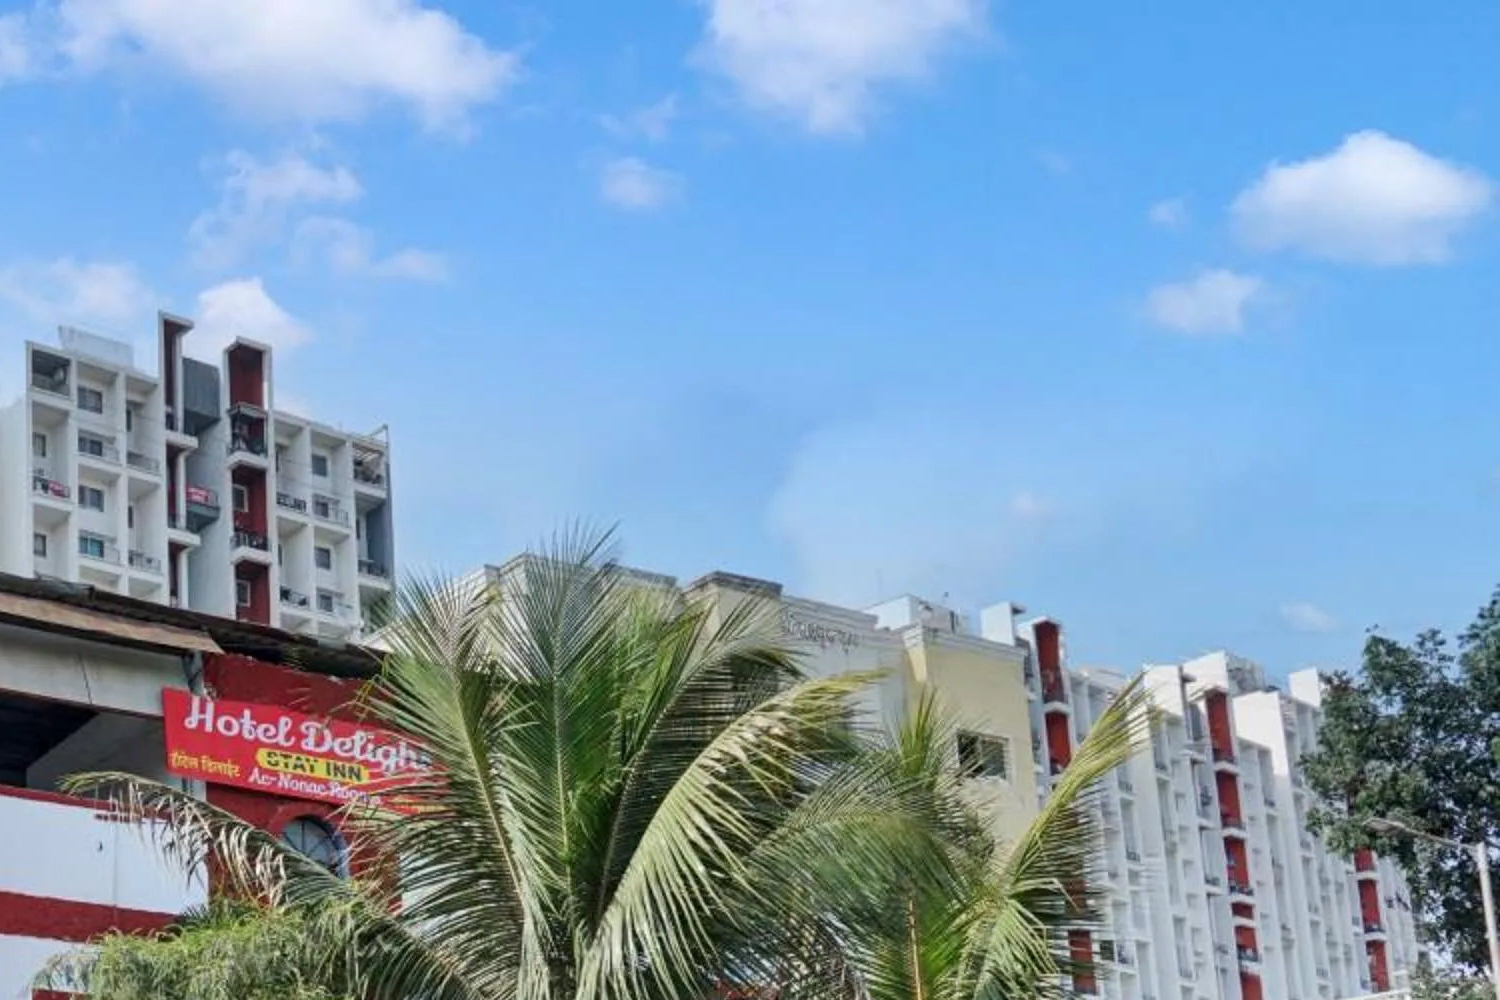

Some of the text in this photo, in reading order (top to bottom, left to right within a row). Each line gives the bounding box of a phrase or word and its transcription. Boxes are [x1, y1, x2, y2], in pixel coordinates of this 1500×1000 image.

[184, 695, 296, 747] Hotel
[266, 751, 361, 783] STAY INN
